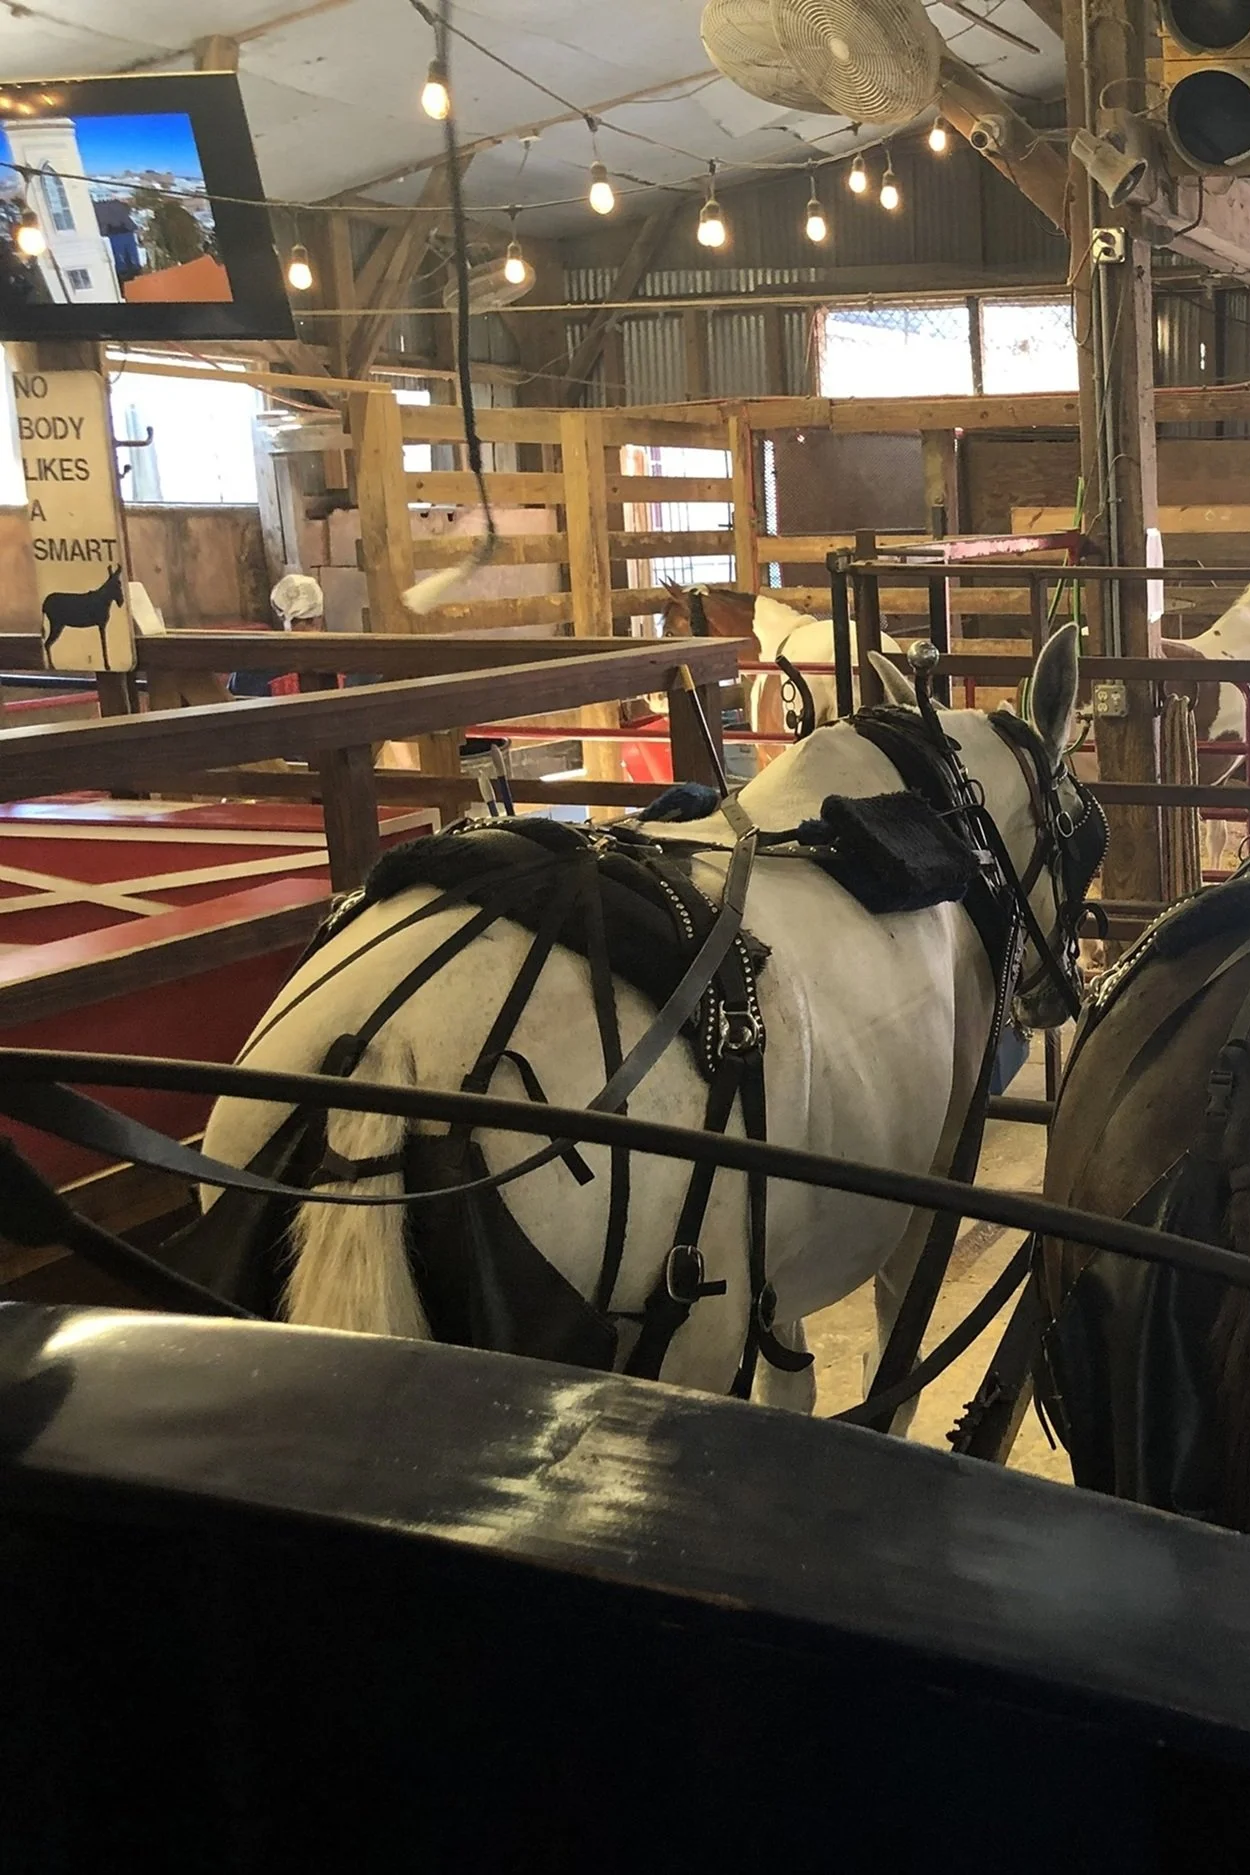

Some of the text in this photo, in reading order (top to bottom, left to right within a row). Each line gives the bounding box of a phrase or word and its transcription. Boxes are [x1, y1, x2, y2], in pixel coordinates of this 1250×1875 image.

[12, 375, 48, 399] NO
[18, 416, 85, 440] BODY
[22, 458, 90, 482] LIKES
[30, 499, 47, 522] A
[34, 539, 117, 562] SMART
